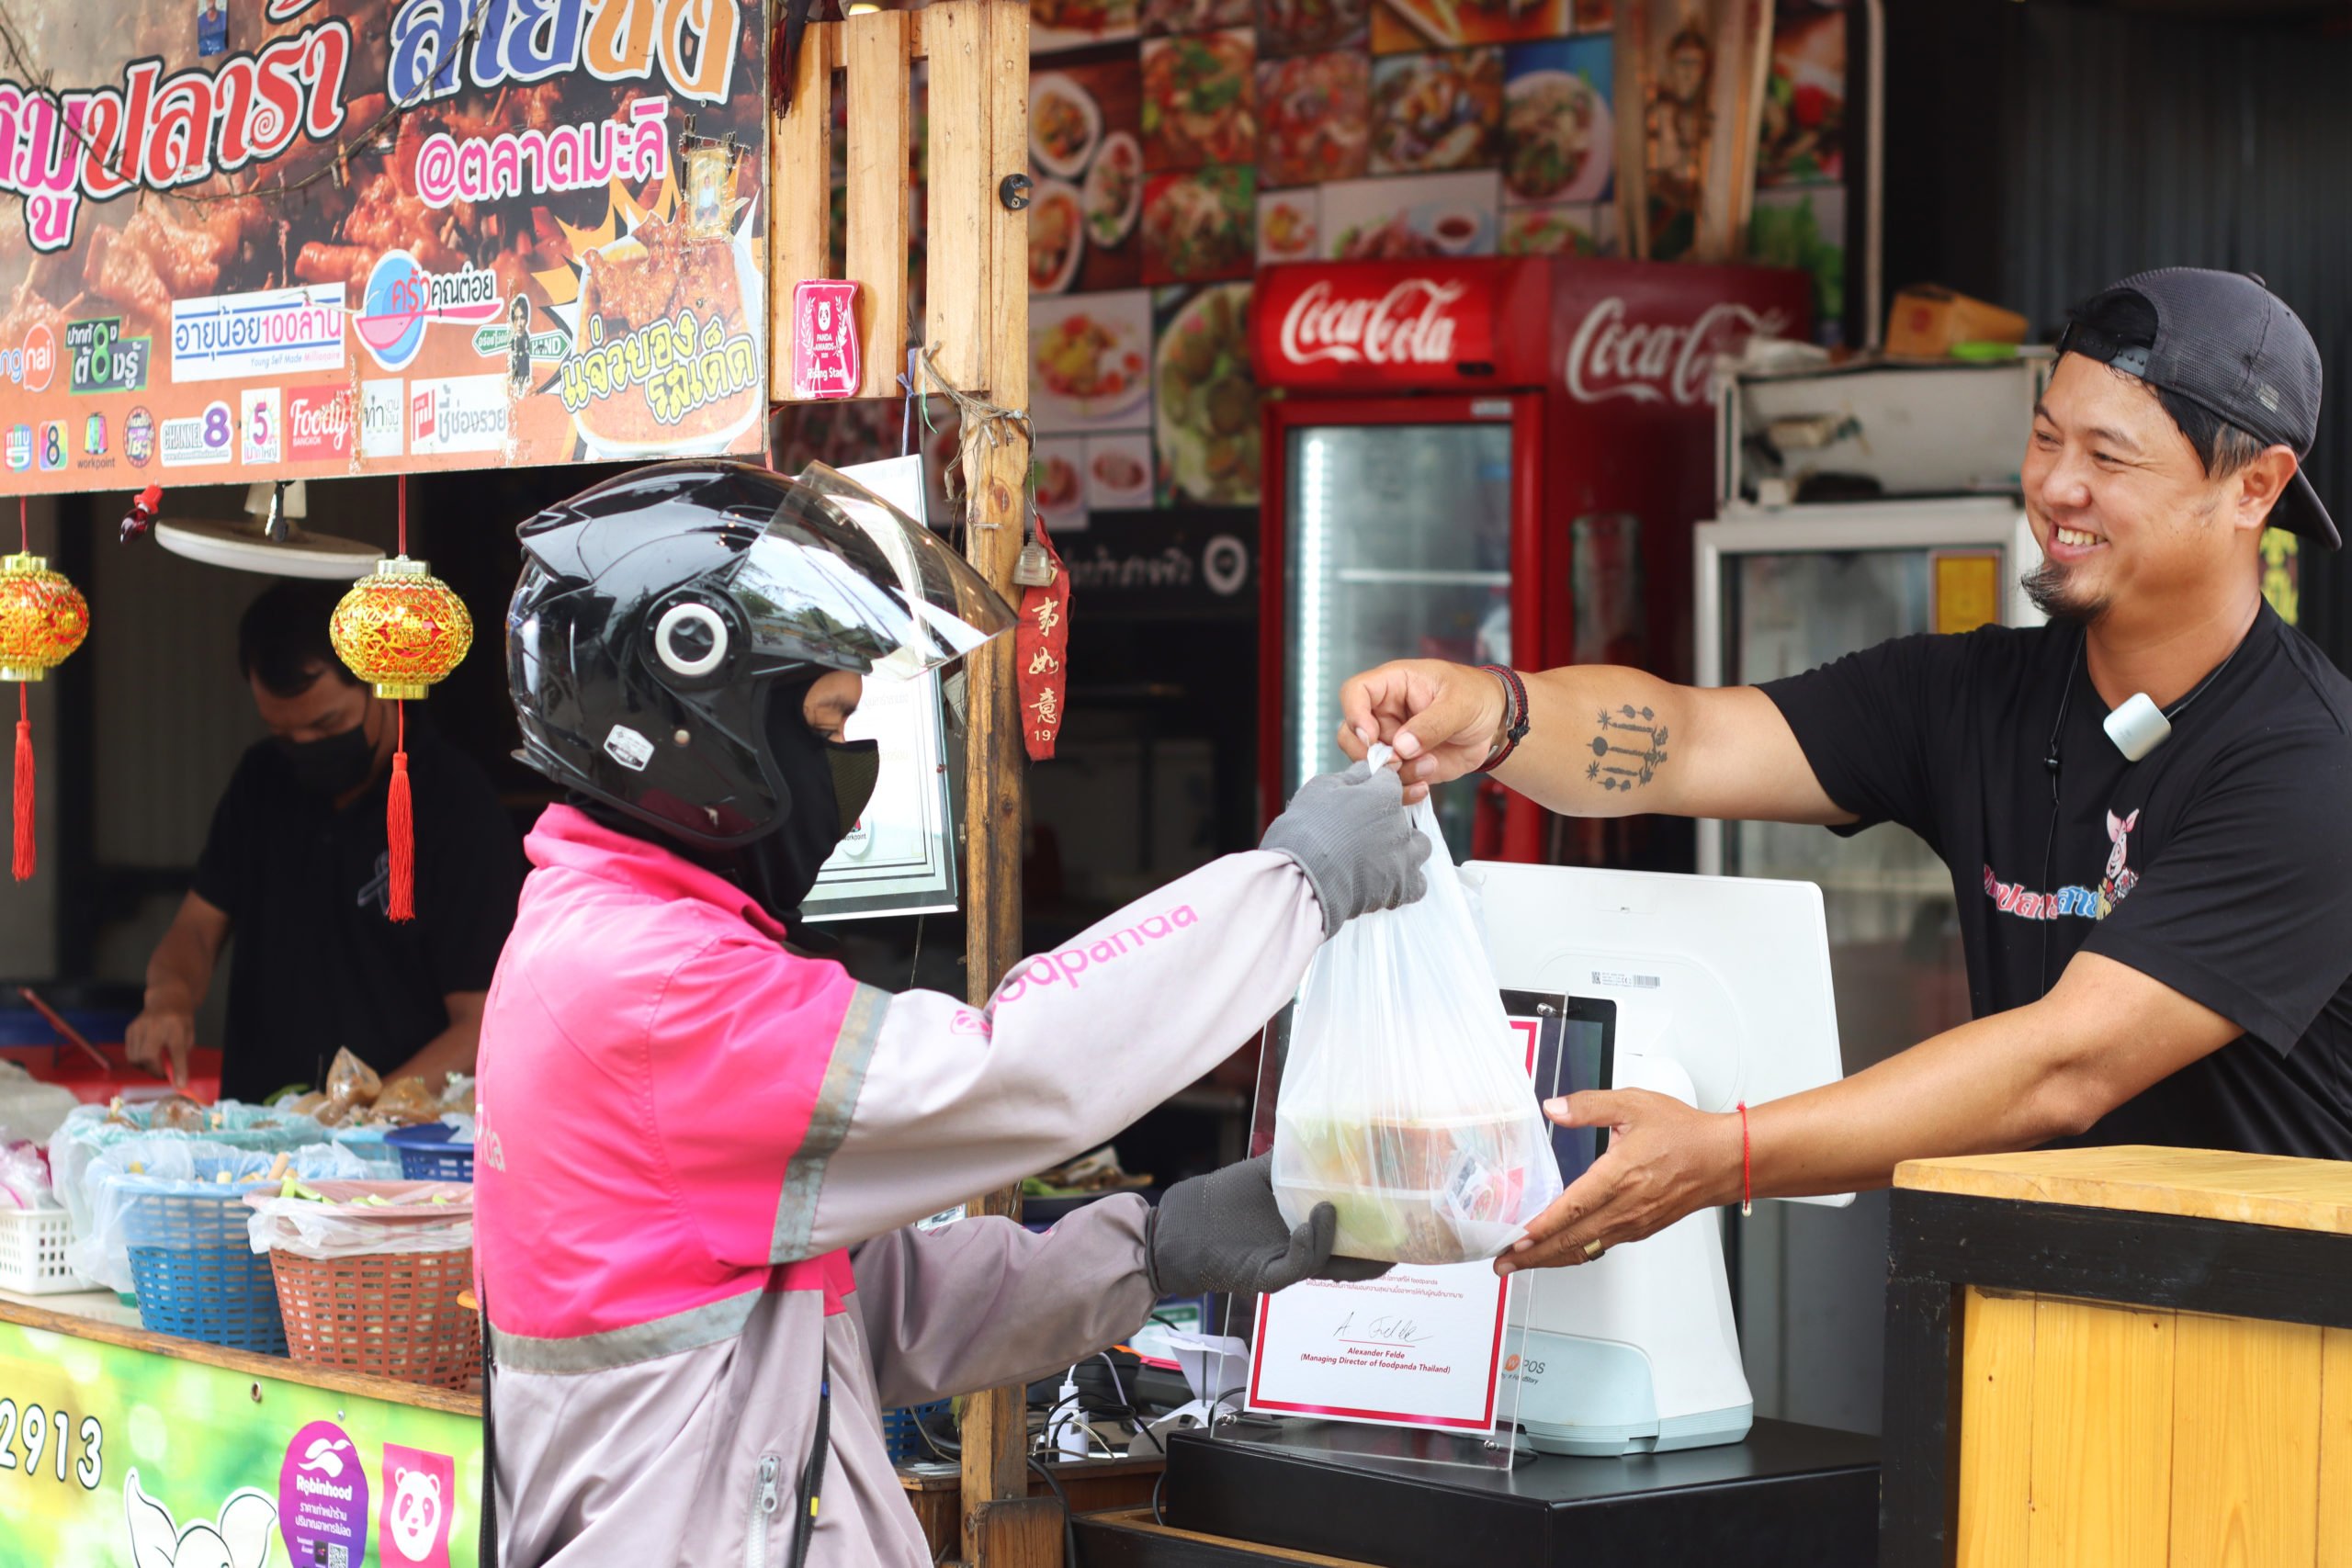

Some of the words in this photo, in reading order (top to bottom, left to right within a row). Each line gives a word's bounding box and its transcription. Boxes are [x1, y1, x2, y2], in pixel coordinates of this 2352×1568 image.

[203, 407, 230, 447] 8
[77, 457, 115, 470] workpoint
[1034, 729, 1056, 741] 19
[1300, 1353, 1337, 1365] (Managing
[1339, 1356, 1367, 1366] Director
[1379, 1361, 1417, 1371] foodpanda
[1419, 1364, 1451, 1374] Thailand)
[1347, 1347, 1383, 1357] Alexander
[1385, 1350, 1405, 1359] Felde
[0, 1397, 103, 1490] 2913
[296, 1474, 353, 1501] Robinhood
